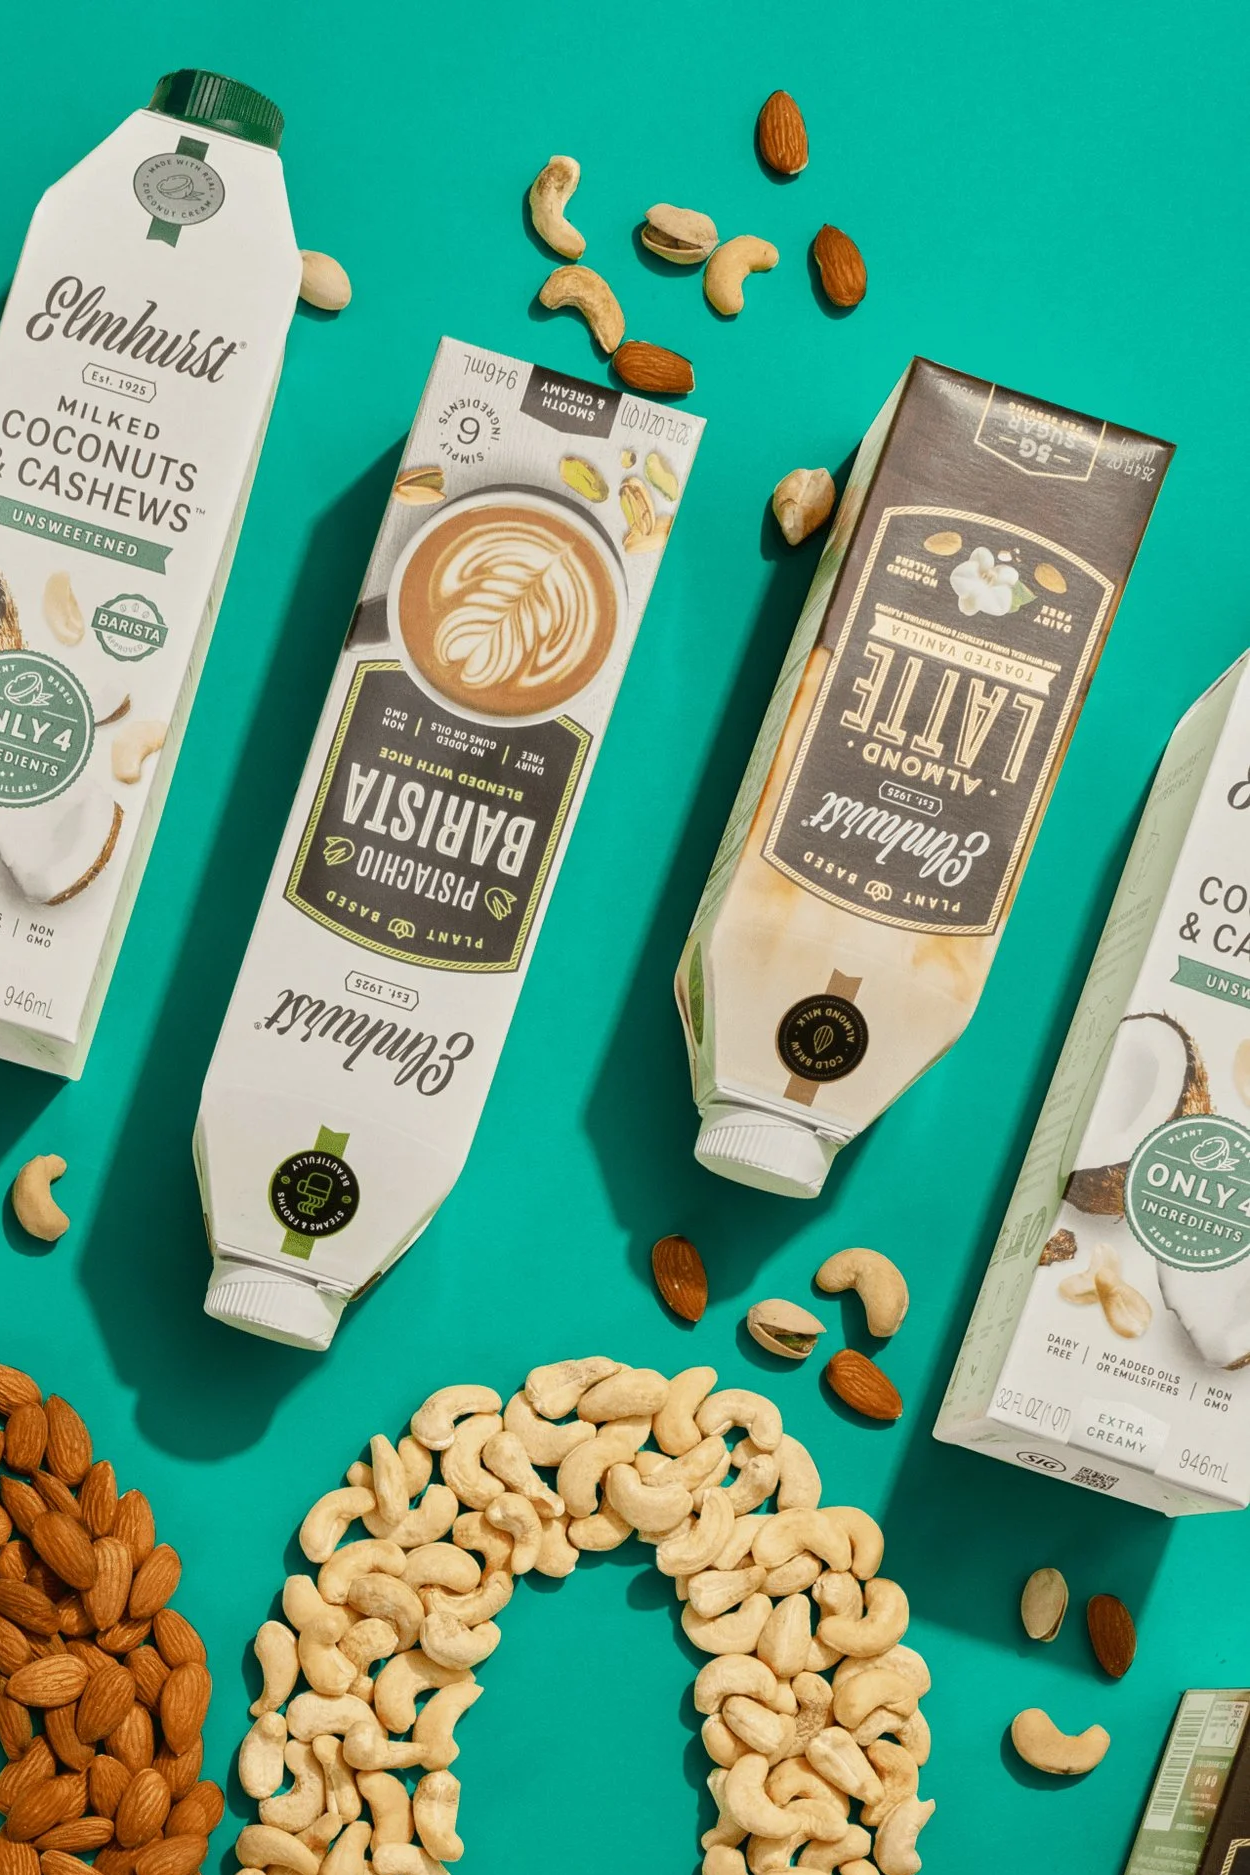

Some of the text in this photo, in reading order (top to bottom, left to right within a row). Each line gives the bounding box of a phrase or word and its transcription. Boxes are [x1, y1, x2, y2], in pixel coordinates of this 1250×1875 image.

[148, 159, 216, 191] MADE WITH REAL
[143, 183, 212, 219] COCONUT CREAM
[464, 354, 519, 389] 946mL
[541, 382, 605, 409] & CREAMY
[541, 396, 596, 422] SMOOTH
[56, 395, 160, 440] MILKED
[1, 409, 198, 492] COCONUTS
[11, 507, 138, 557] UNSWEETENED
[98, 612, 159, 642] BARISTA
[892, 624, 1034, 681] TOASTED VANILLA
[840, 642, 1043, 783] LATTE
[52, 729, 72, 752] 4
[862, 743, 982, 795] ALMOND
[342, 763, 536, 877] BARISTA
[355, 845, 480, 911] PISTACHIO
[1146, 1162, 1237, 1207] ONLY
[1140, 1198, 1242, 1242] INGREDIENTS
[1047, 1333, 1079, 1350] DAIRY
[1047, 1345, 1072, 1360] FREE
[1085, 1425, 1147, 1452] CREAMY
[1098, 1413, 1142, 1436] EXTRA
[1177, 1448, 1225, 1483] 946mL
